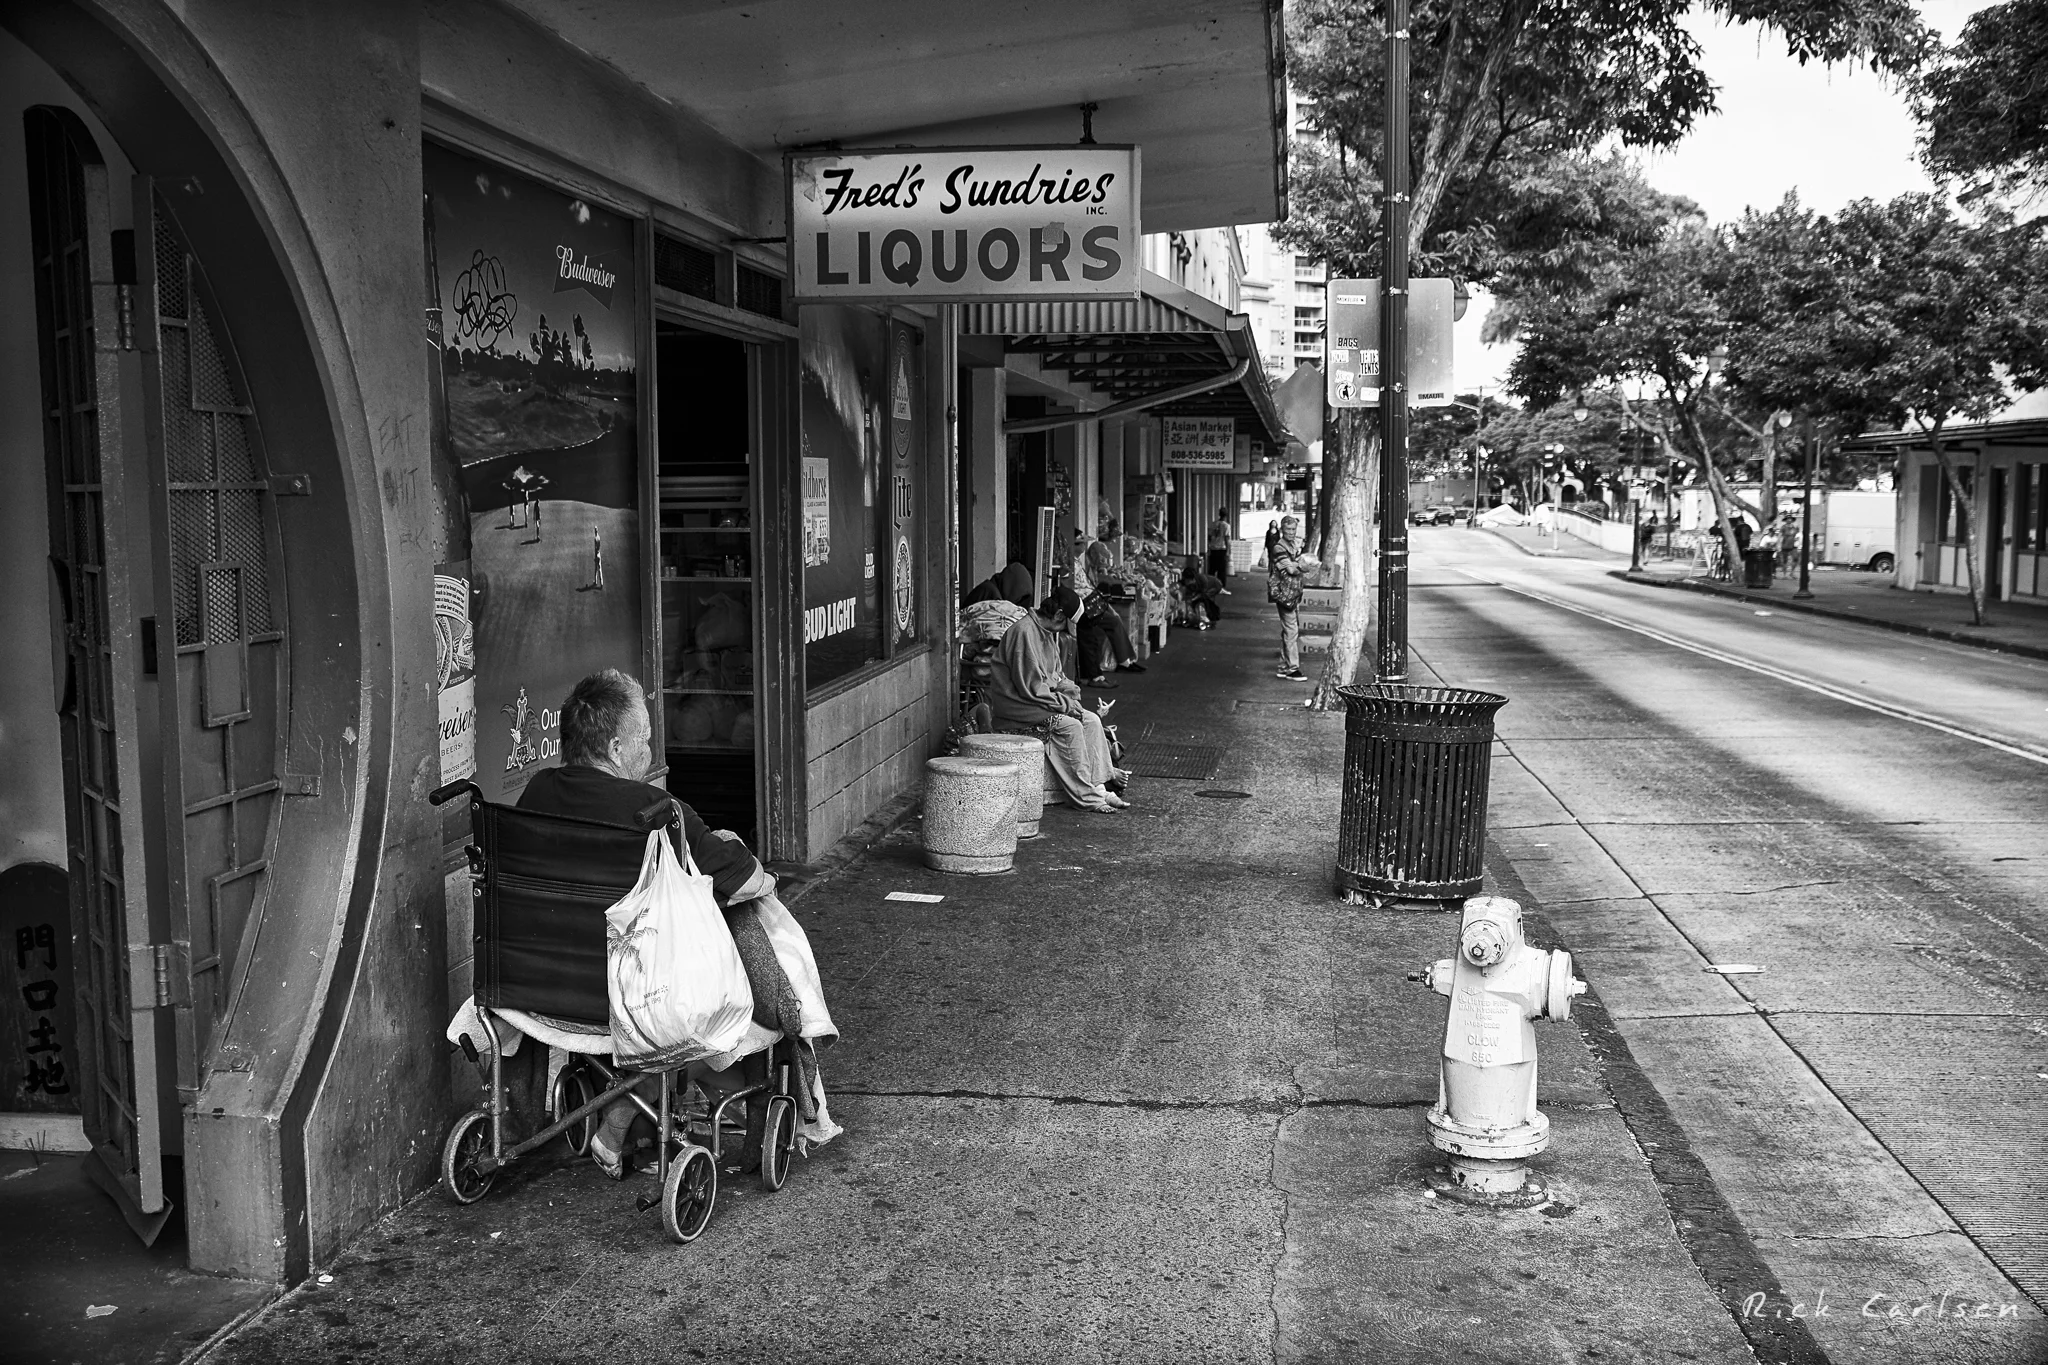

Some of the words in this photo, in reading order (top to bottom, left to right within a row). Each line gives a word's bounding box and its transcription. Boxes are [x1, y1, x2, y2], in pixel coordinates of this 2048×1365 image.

[822, 164, 925, 215] Fred's
[940, 163, 1115, 214] Sundries
[1085, 206, 1108, 215] INC.
[556, 245, 615, 288] Budweiser
[816, 225, 1122, 288] LIQUORS
[1338, 337, 1358, 347] BAGS
[1361, 363, 1379, 374] TENTS
[1171, 421, 1197, 432] Asian
[1200, 421, 1232, 432] Market
[1171, 451, 1225, 460] 808-536-5985
[893, 475, 912, 530] Lite
[804, 606, 827, 645] BUD
[827, 596, 856, 637] LIGHT
[541, 708, 561, 731] Our
[541, 737, 561, 759] Our
[16, 923, 71, 1095] 門口土地
[1467, 1034, 1499, 1047] CLOW
[1471, 1051, 1492, 1063] 850
